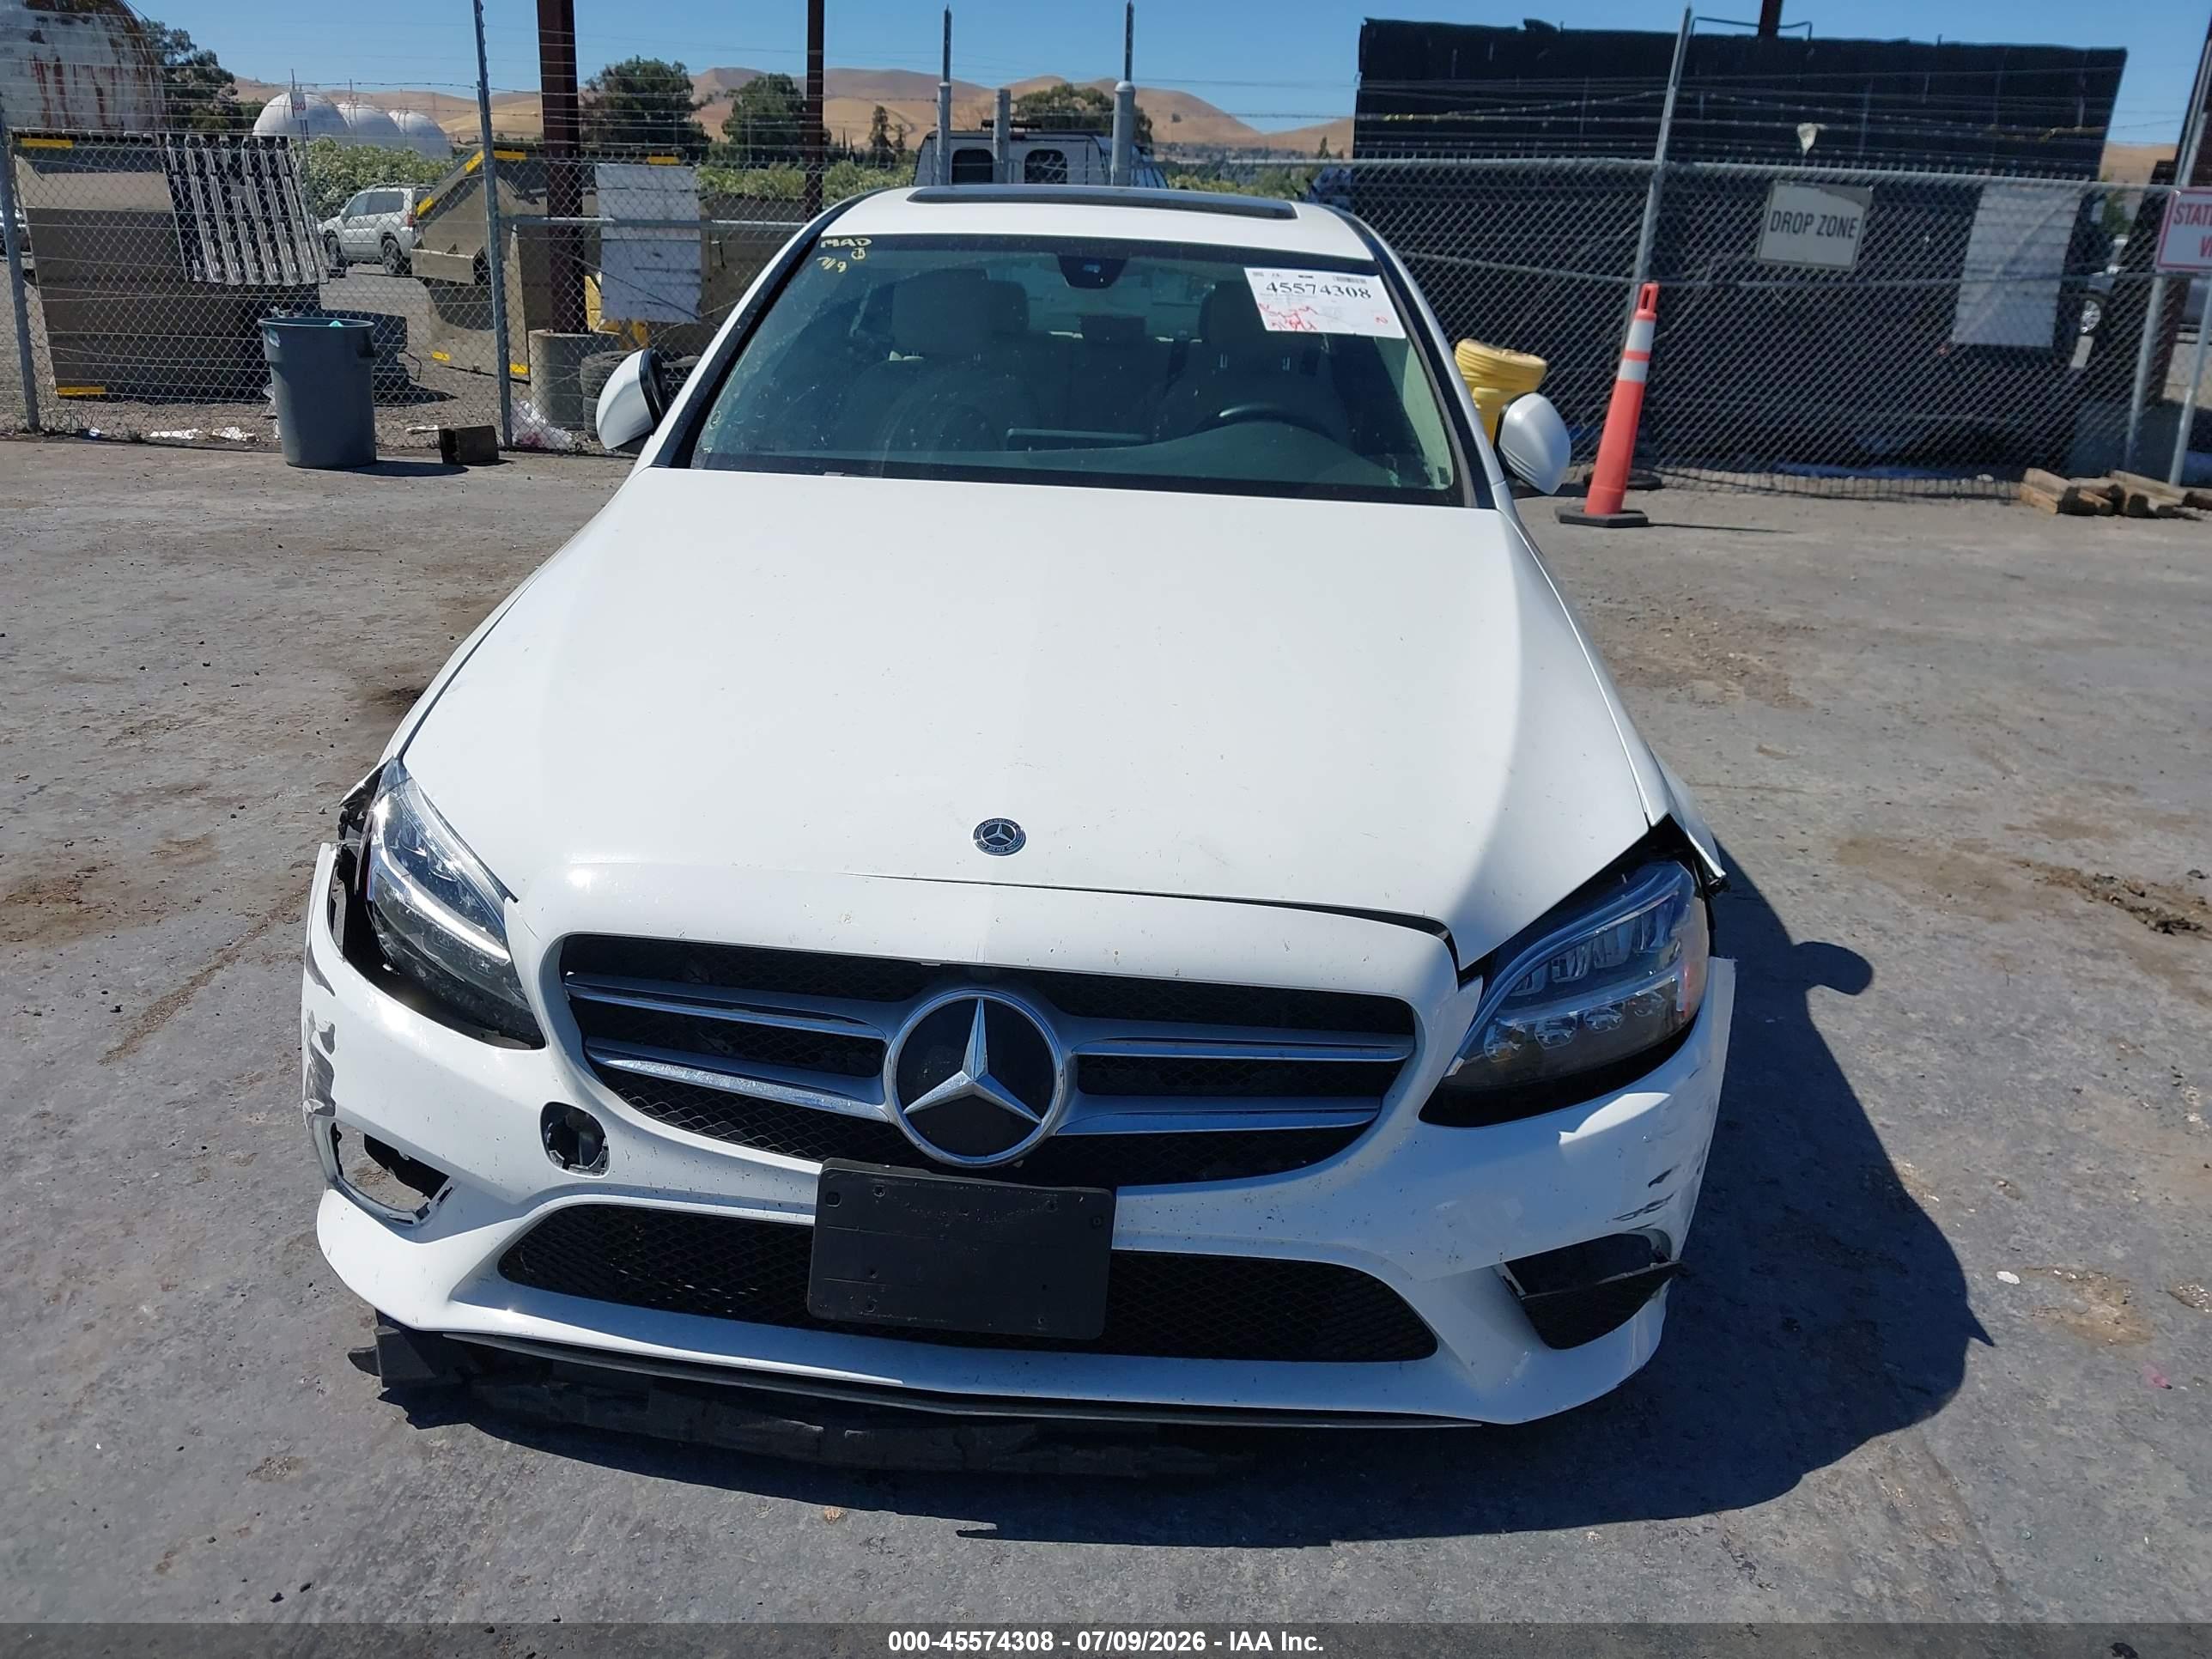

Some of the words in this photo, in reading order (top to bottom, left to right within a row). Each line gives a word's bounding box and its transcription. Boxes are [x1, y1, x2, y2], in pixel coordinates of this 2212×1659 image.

[1770, 210, 1814, 234] DROP
[1816, 214, 1858, 239] ZONE
[2173, 203, 2212, 227] STAT
[1266, 282, 1371, 299] 45574308
